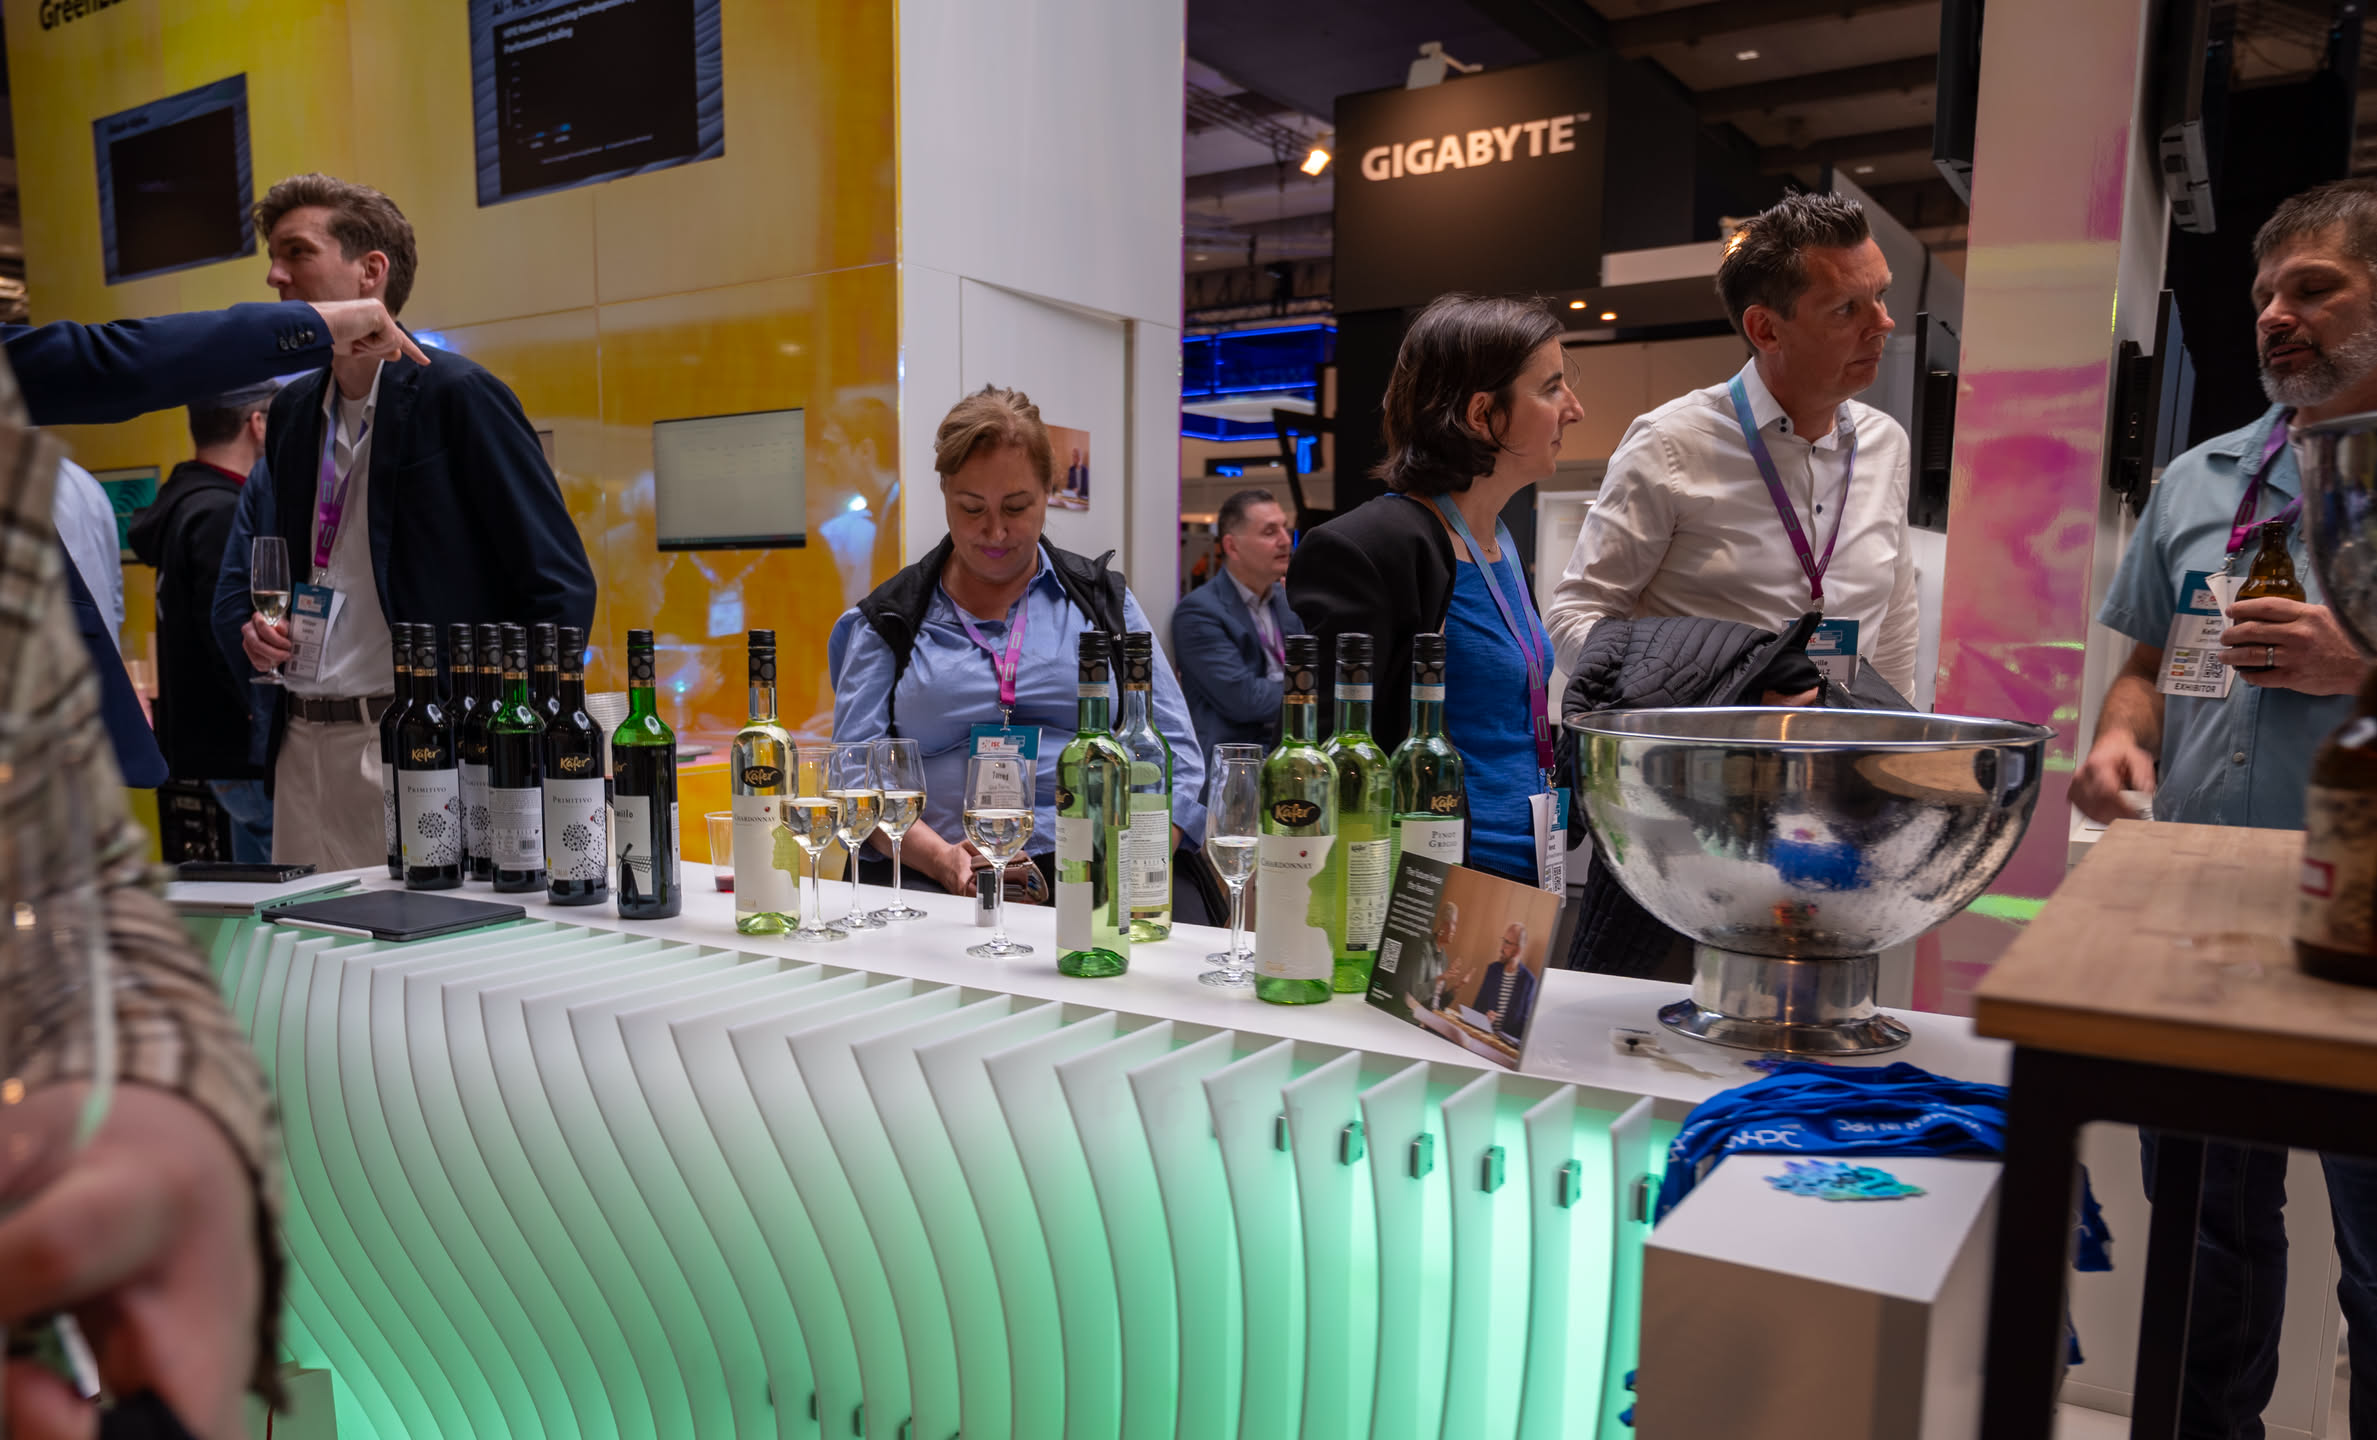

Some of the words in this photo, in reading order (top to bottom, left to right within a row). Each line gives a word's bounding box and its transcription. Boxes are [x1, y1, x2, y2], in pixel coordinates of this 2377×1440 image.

[2174, 682, 2216, 693] EXHIBITOR
[411, 747, 441, 763] Käfer
[560, 757, 591, 772] Käfer
[745, 768, 778, 785] Käfer
[1274, 803, 1316, 823] Käfer
[1431, 830, 1457, 839] PINOT
[1261, 857, 1313, 869] CHARDONNAY
